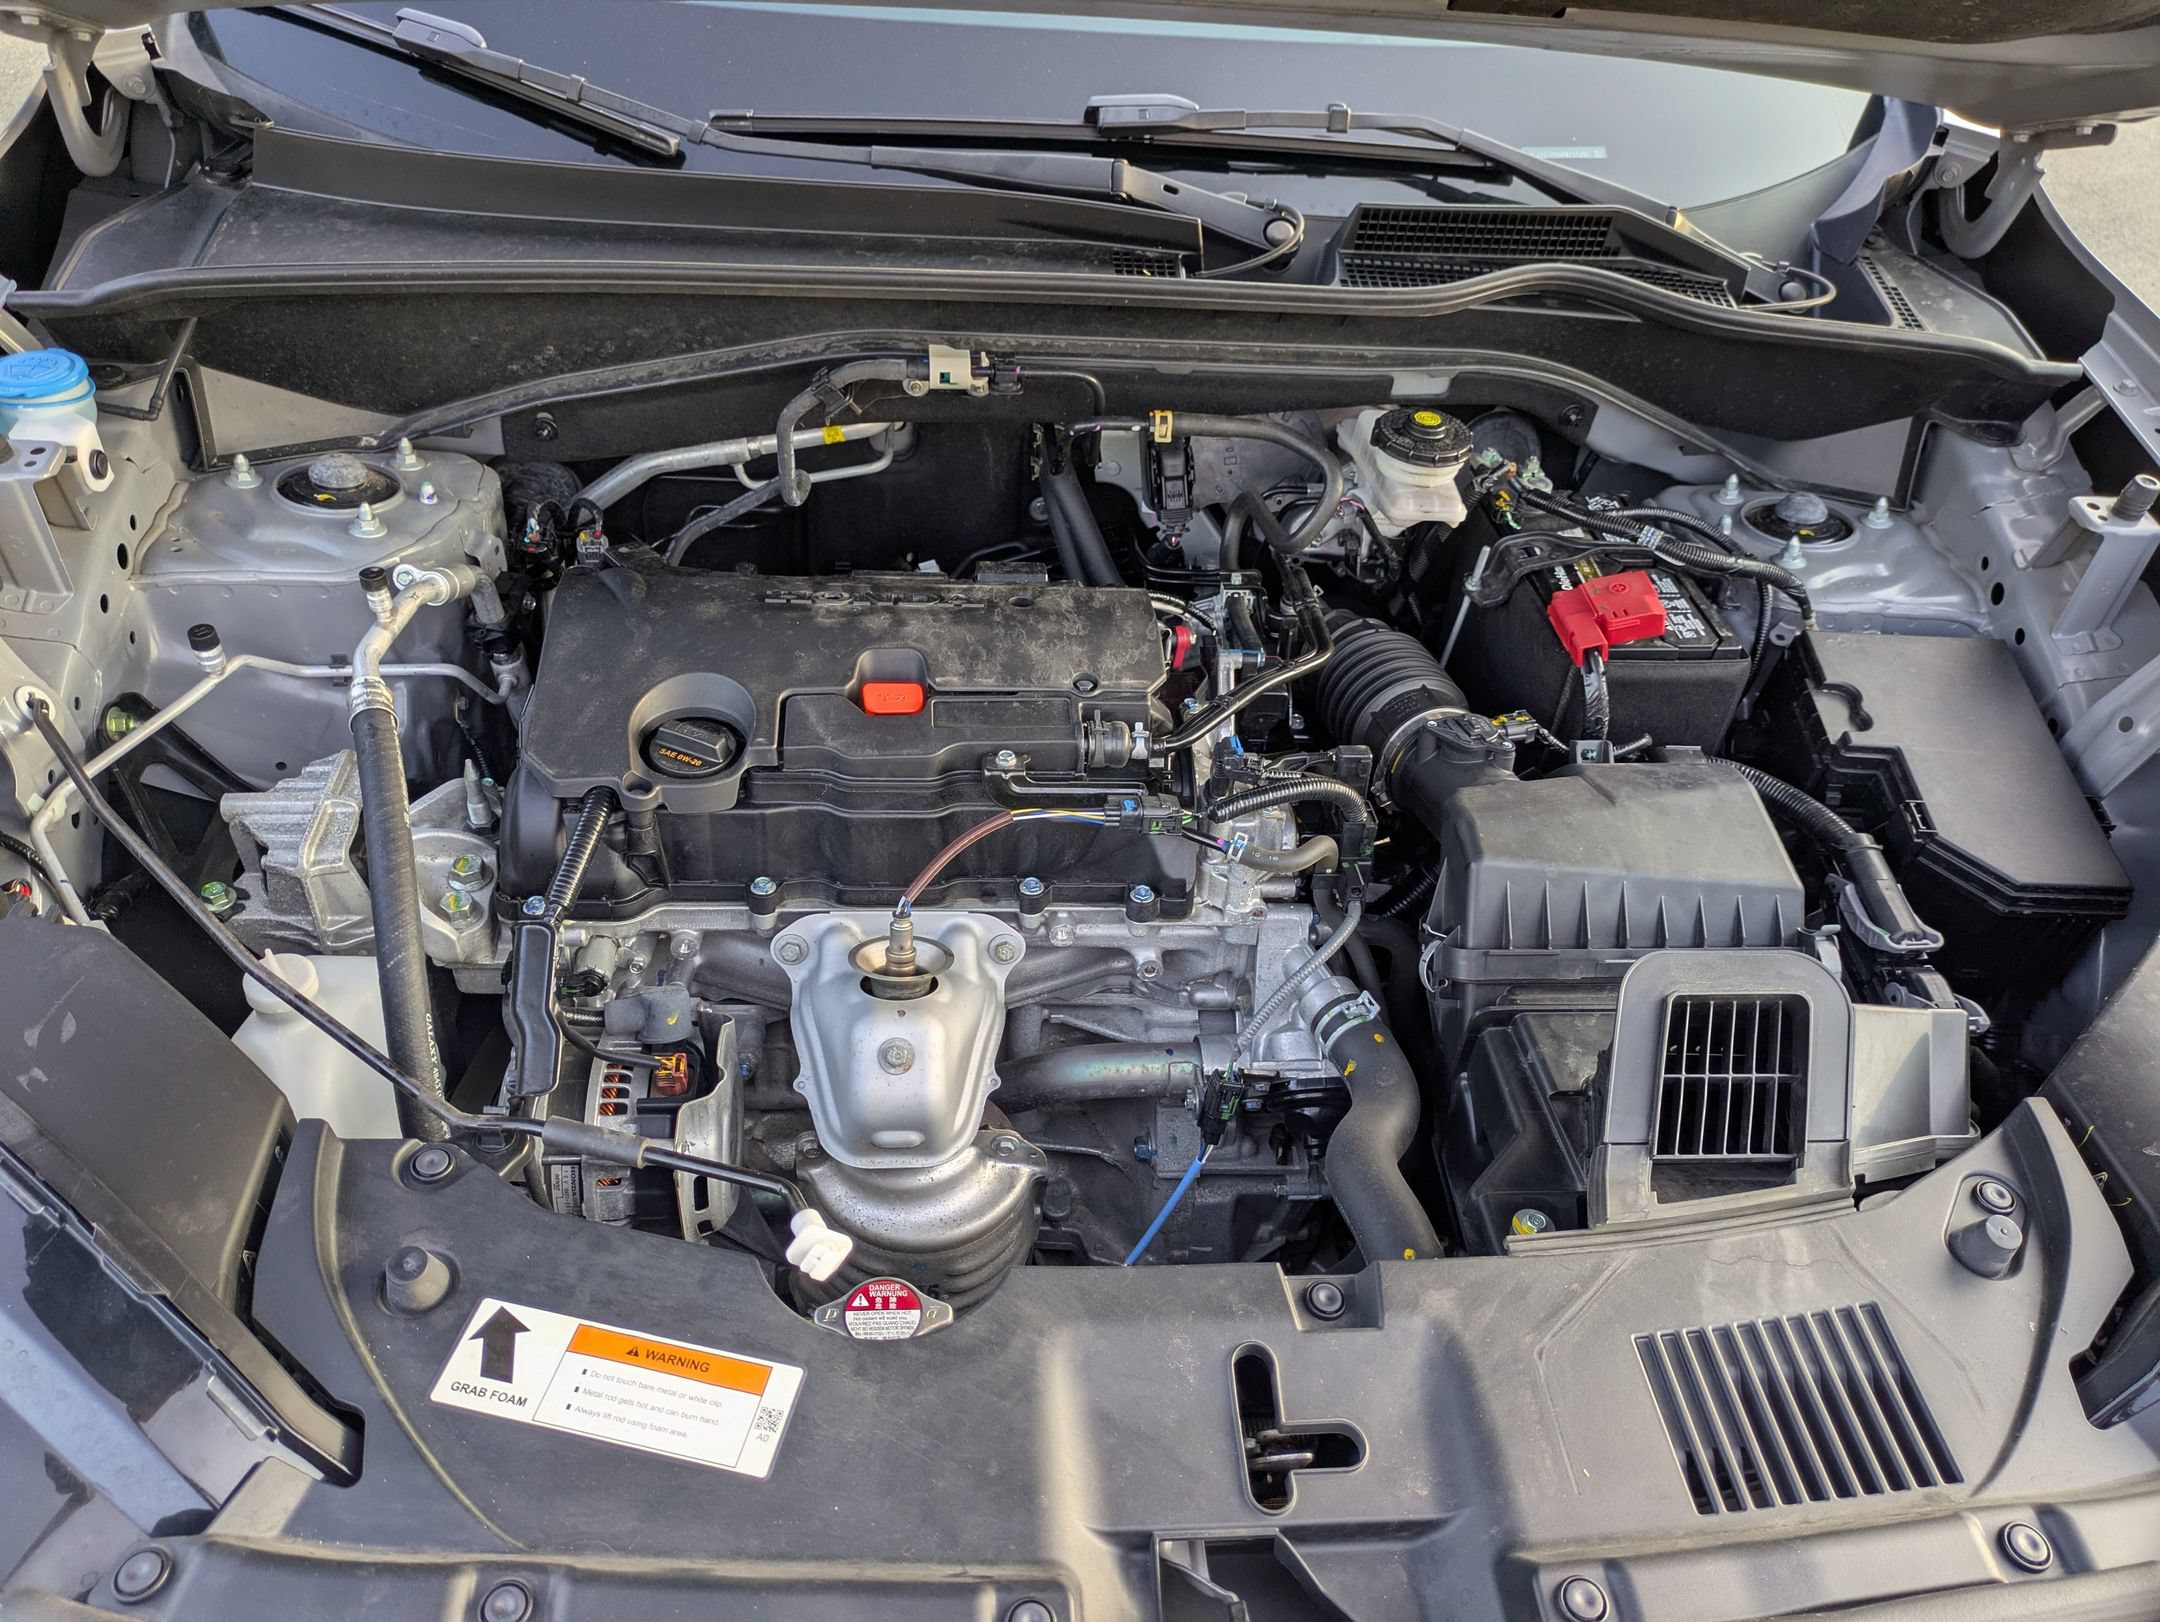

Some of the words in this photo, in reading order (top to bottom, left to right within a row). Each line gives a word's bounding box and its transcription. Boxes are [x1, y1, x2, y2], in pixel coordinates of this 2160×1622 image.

[1554, 566, 1573, 590] DieHa
[765, 590, 984, 608] HONDA
[660, 748, 678, 758] SAE
[677, 754, 702, 766] 0W-20
[426, 1013, 437, 1064] GALAXY
[646, 1350, 710, 1373] WARNING
[450, 1381, 488, 1397] GRAB
[489, 1390, 528, 1407] FOAM
[590, 1370, 602, 1378] Do
[602, 1374, 615, 1382] not
[616, 1376, 637, 1387] touch
[638, 1382, 655, 1391] bare
[656, 1386, 678, 1397] metal
[688, 1394, 708, 1404] white
[709, 1399, 723, 1408] clip.
[582, 1387, 603, 1398] Metal
[605, 1393, 618, 1402] rod
[618, 1397, 635, 1406] gets
[636, 1400, 649, 1409] hot
[650, 1405, 665, 1413] and
[665, 1408, 679, 1416] can
[681, 1411, 698, 1421] burn
[574, 1405, 601, 1418] Always
[603, 1411, 612, 1419] lift
[613, 1414, 627, 1424] rod
[627, 1418, 648, 1430] using
[649, 1423, 669, 1433] foam
